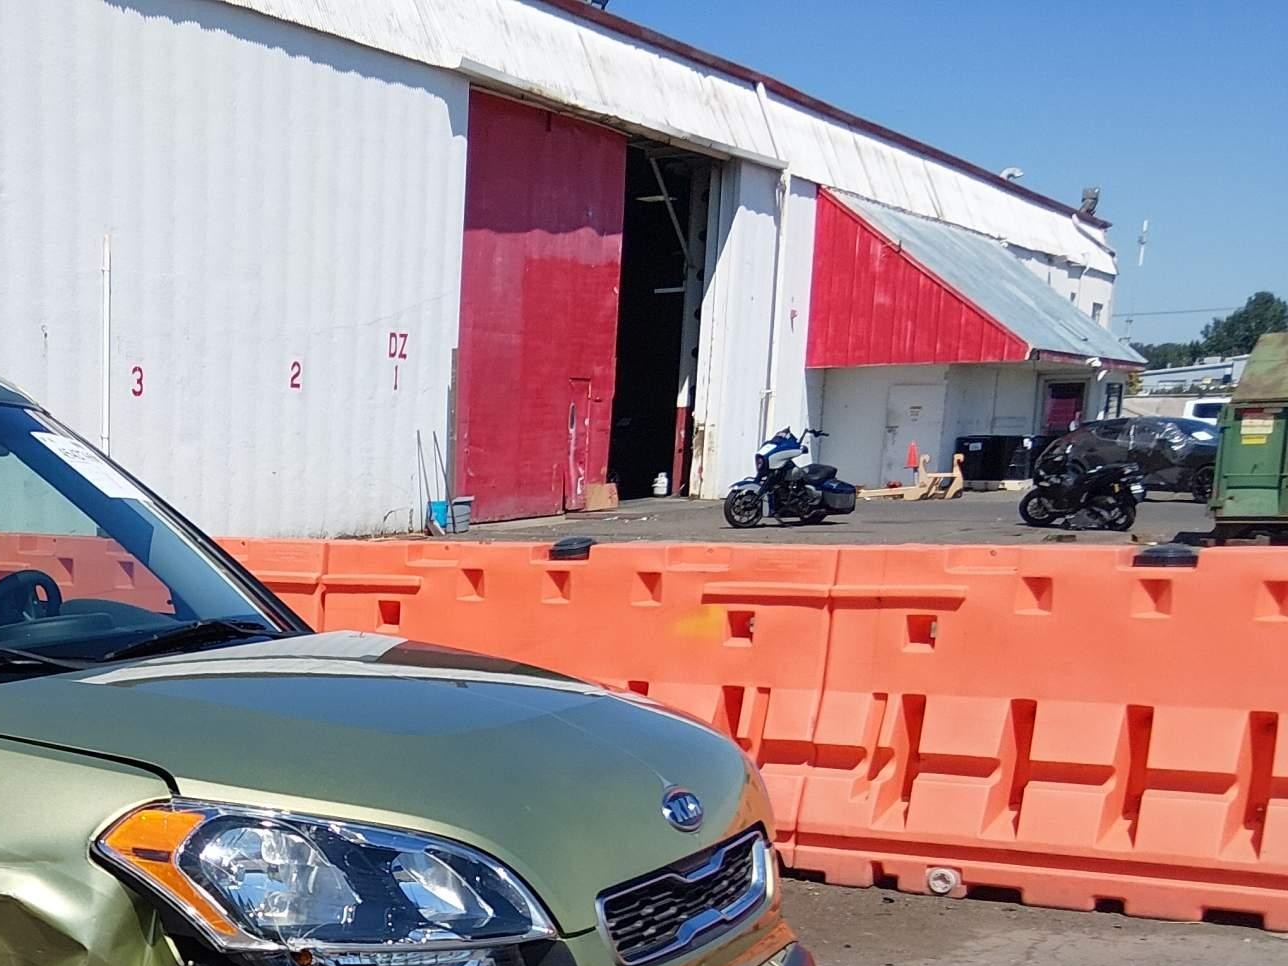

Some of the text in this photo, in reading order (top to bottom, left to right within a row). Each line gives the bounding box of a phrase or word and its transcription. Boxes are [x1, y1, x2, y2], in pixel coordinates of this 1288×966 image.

[388, 332, 409, 360] DZ
[131, 366, 144, 397] 3
[290, 361, 302, 389] 2
